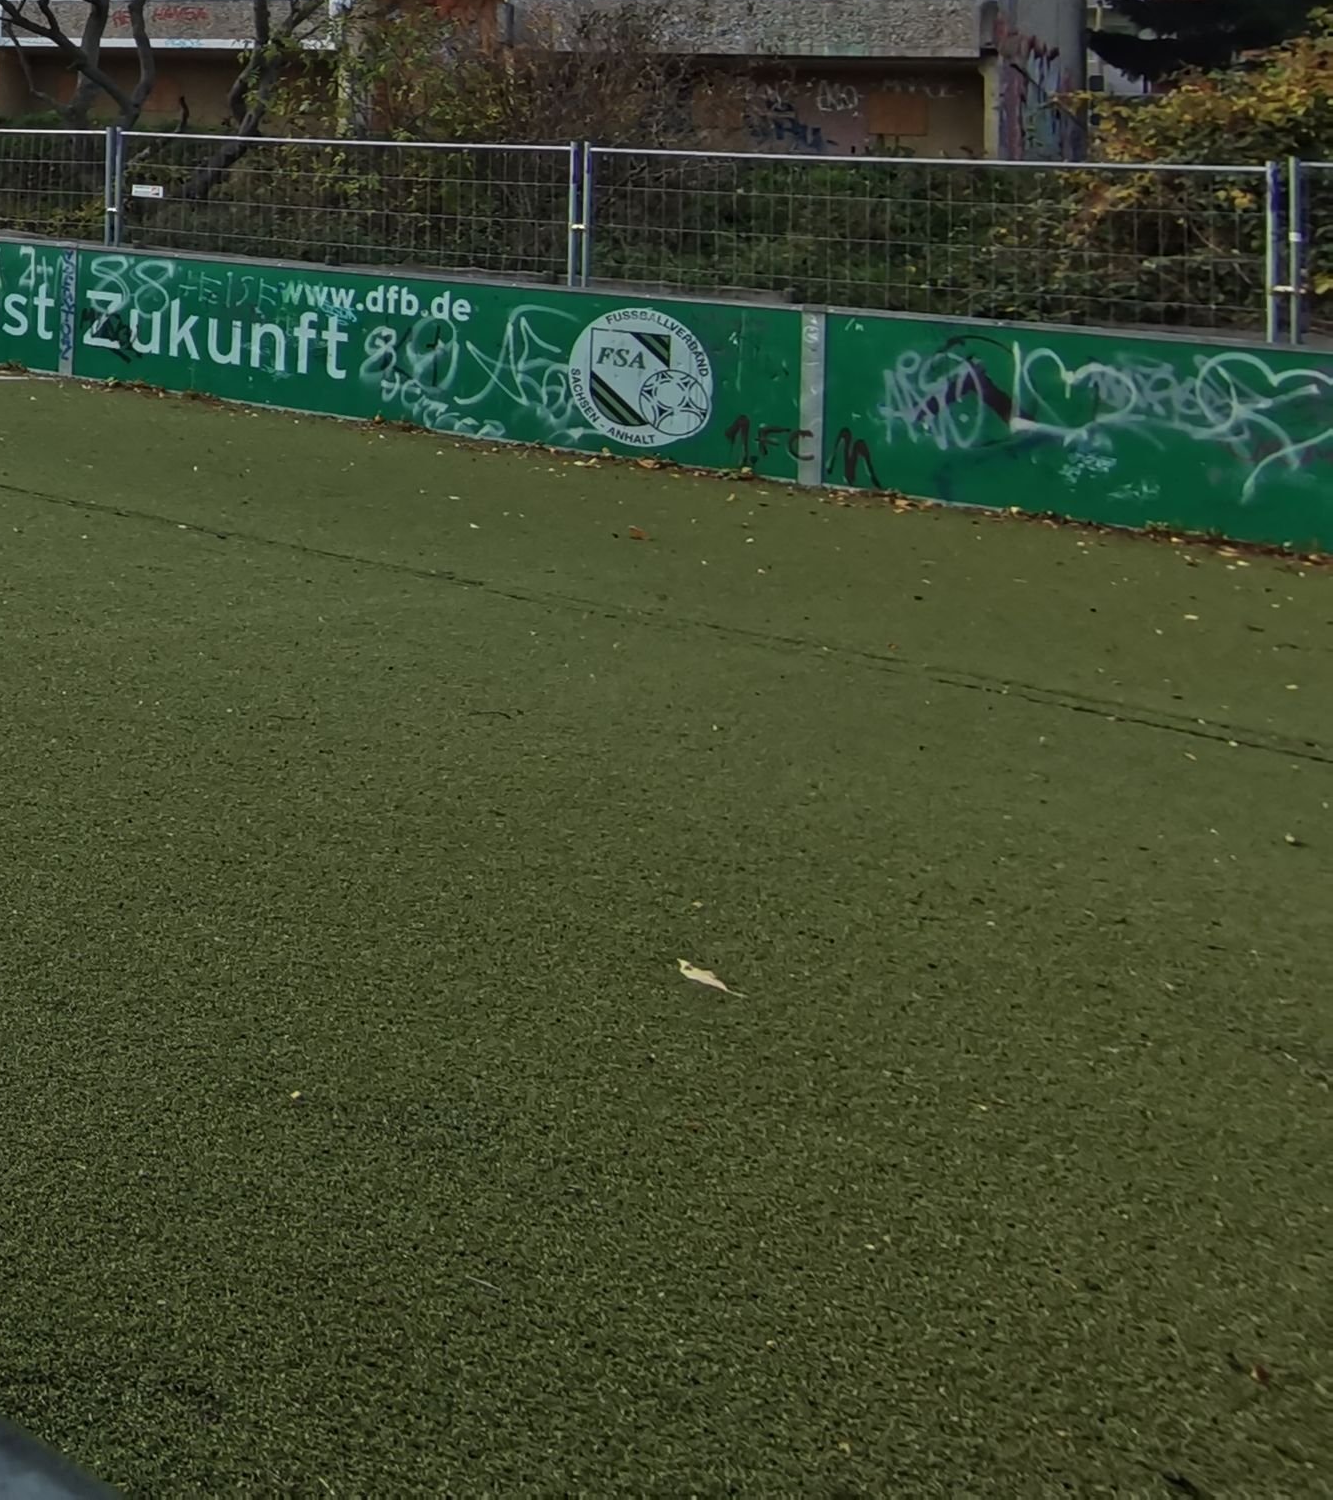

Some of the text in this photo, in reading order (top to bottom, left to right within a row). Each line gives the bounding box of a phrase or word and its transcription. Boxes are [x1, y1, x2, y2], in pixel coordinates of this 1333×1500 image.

[83, 290, 348, 379] Zukunft
[284, 282, 472, 321] www.dfb.de
[596, 347, 646, 370] FSA
[606, 311, 708, 377] FUSSBALLVERBAND
[571, 368, 600, 424] SACHSEN
[607, 427, 655, 444] ANHALT
